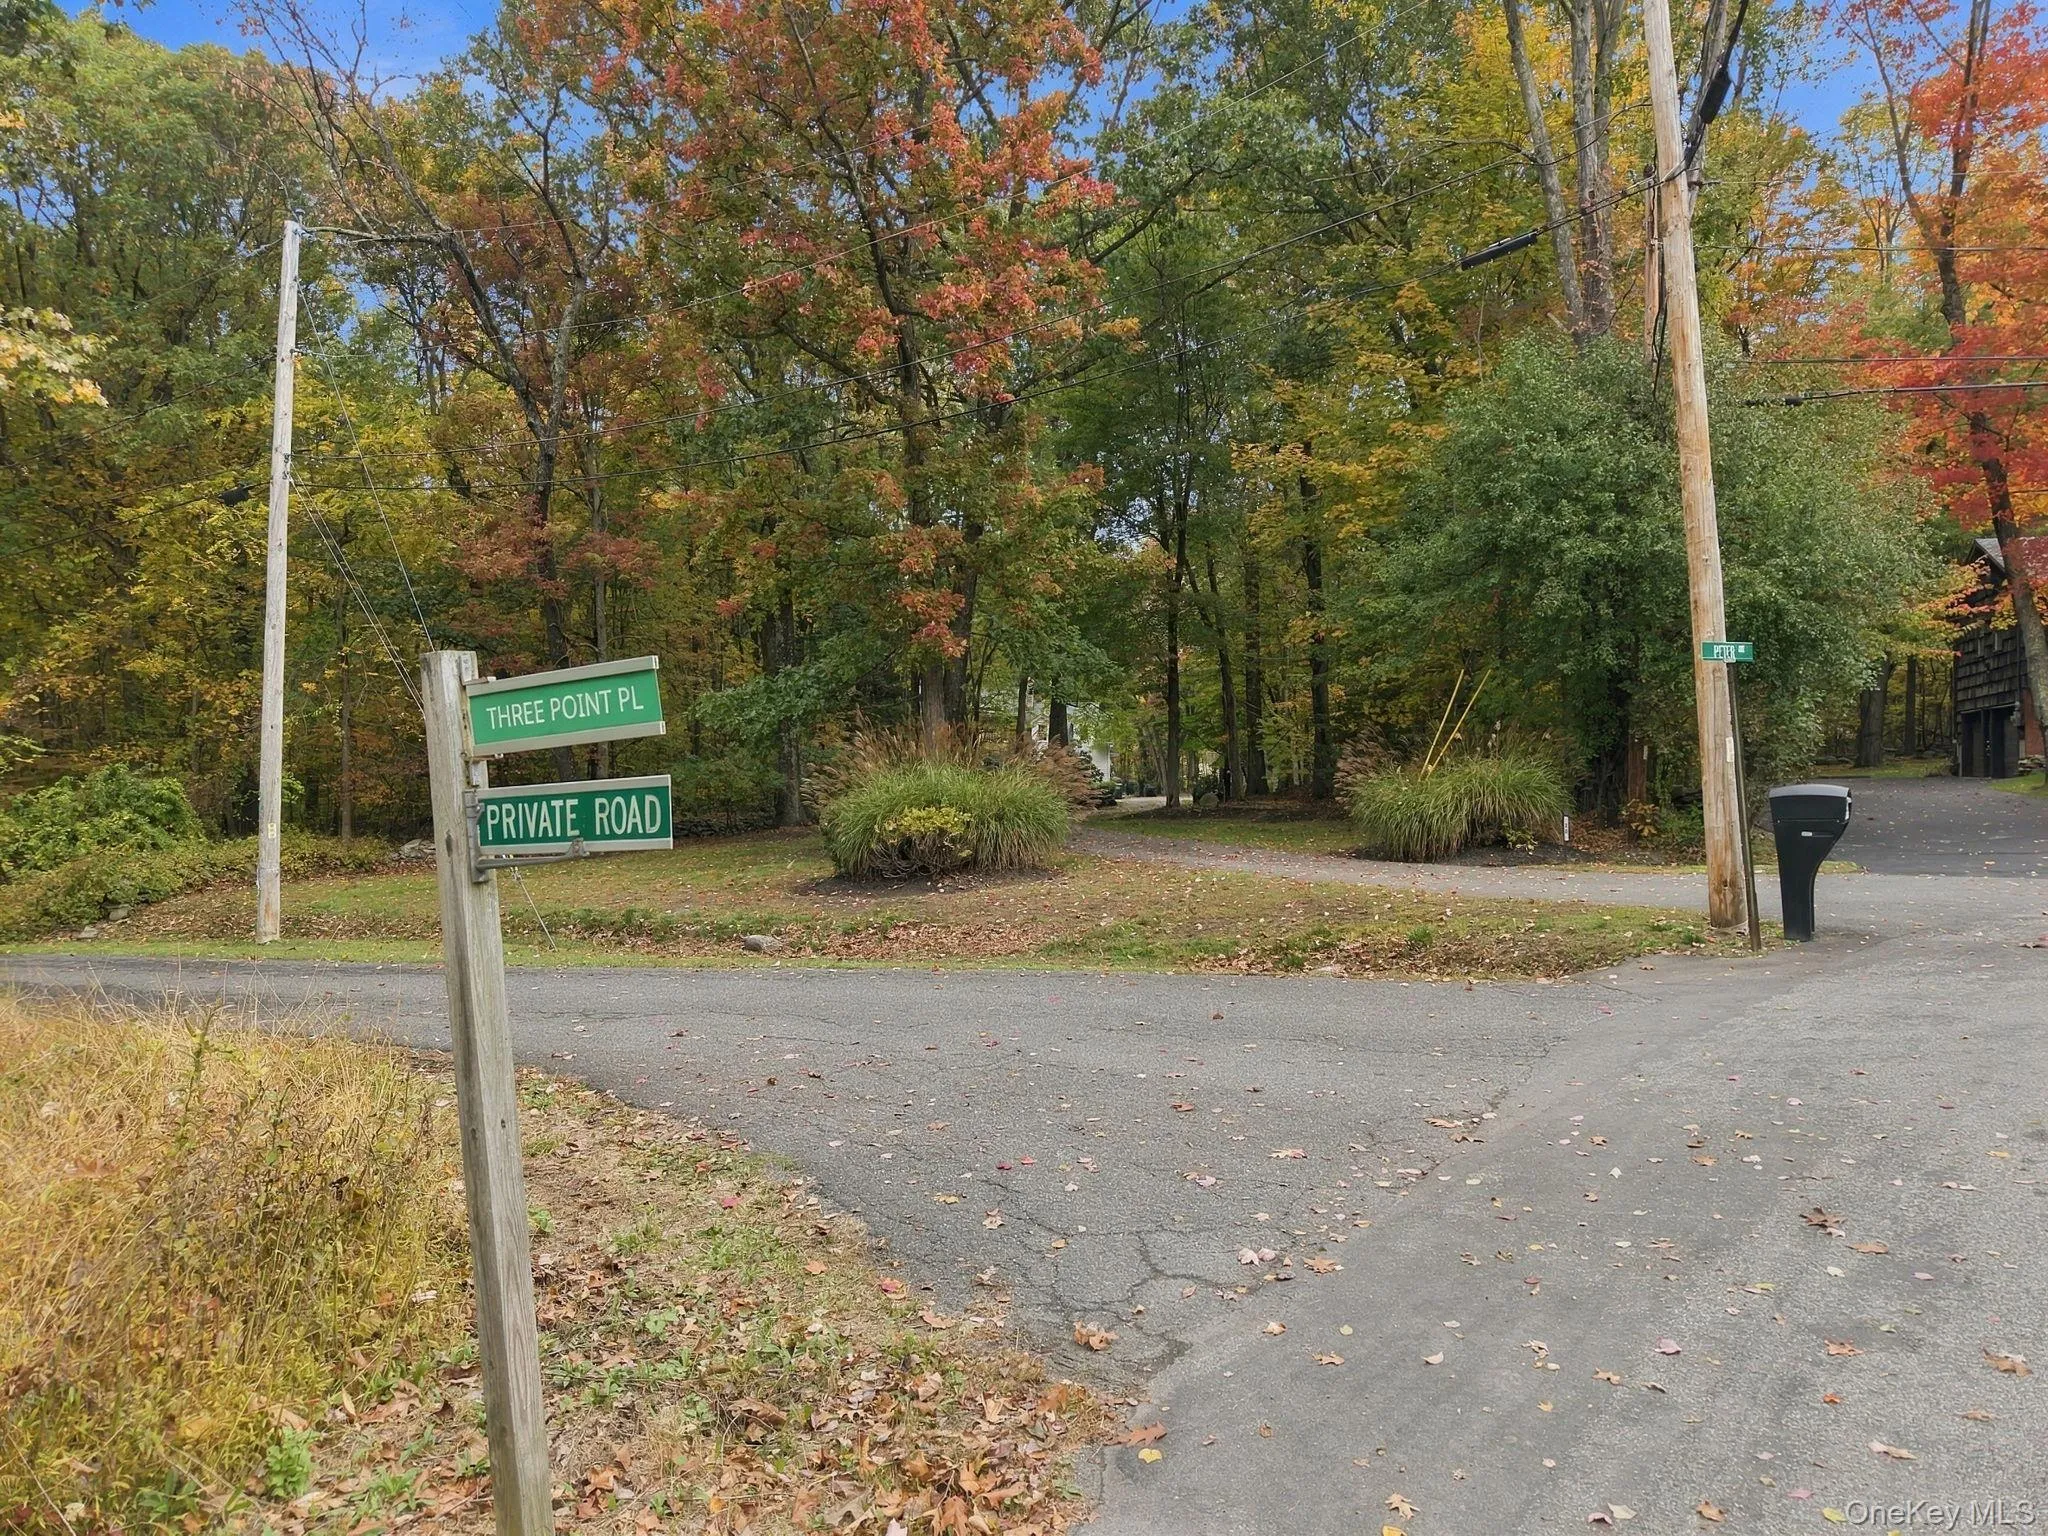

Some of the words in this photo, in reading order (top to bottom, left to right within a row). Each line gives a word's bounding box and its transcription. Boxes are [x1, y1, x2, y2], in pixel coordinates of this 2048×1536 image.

[1713, 645, 1736, 660] PETER
[486, 700, 545, 729] THREE
[550, 689, 612, 721] POINT
[618, 685, 644, 712] PL
[486, 799, 580, 840] PRIVATE
[594, 795, 661, 836] ROAD
